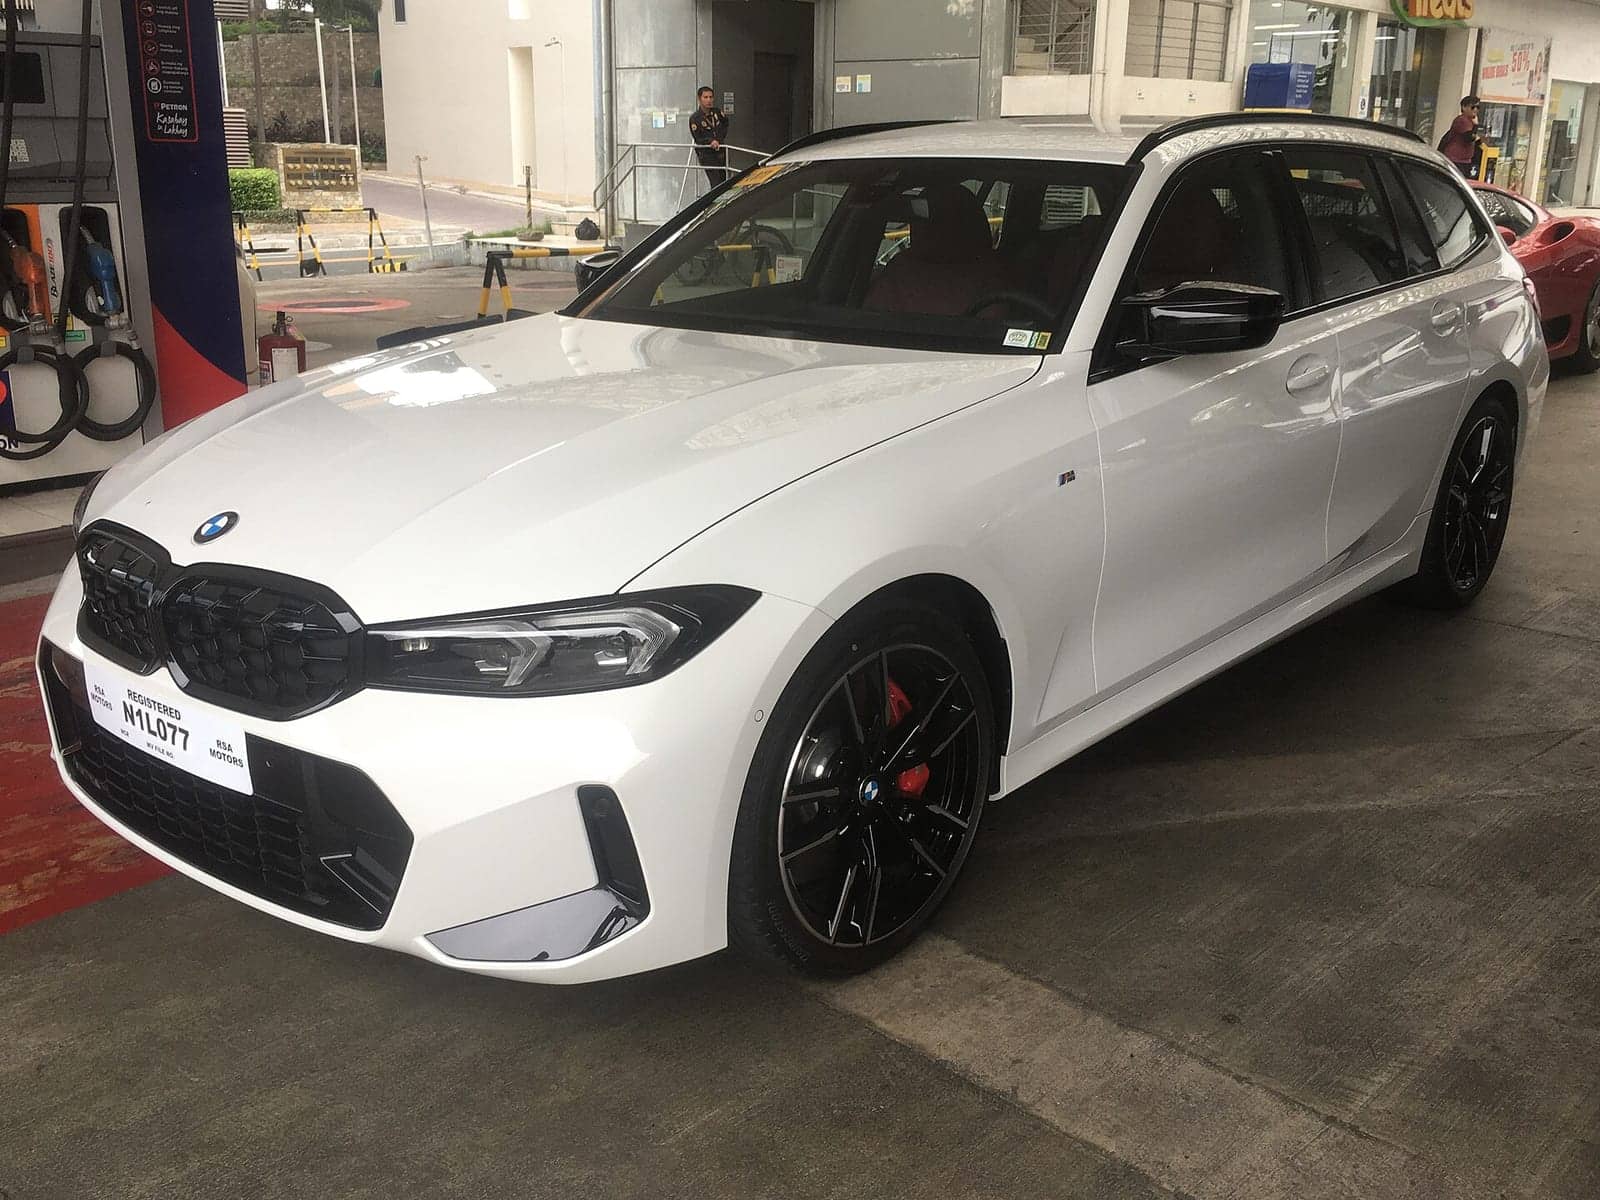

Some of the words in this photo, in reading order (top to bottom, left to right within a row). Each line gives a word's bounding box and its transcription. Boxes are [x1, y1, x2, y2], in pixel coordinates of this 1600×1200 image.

[160, 103, 187, 111] PETRON
[156, 112, 188, 126] Kasabay
[163, 125, 188, 138] Lakbay
[94, 684, 105, 697] RSA
[90, 692, 113, 711] MOTORS
[127, 689, 181, 721] REGISTERED
[122, 700, 190, 751] N1L077
[216, 739, 233, 753] RSA
[209, 748, 244, 768] MOTORS
